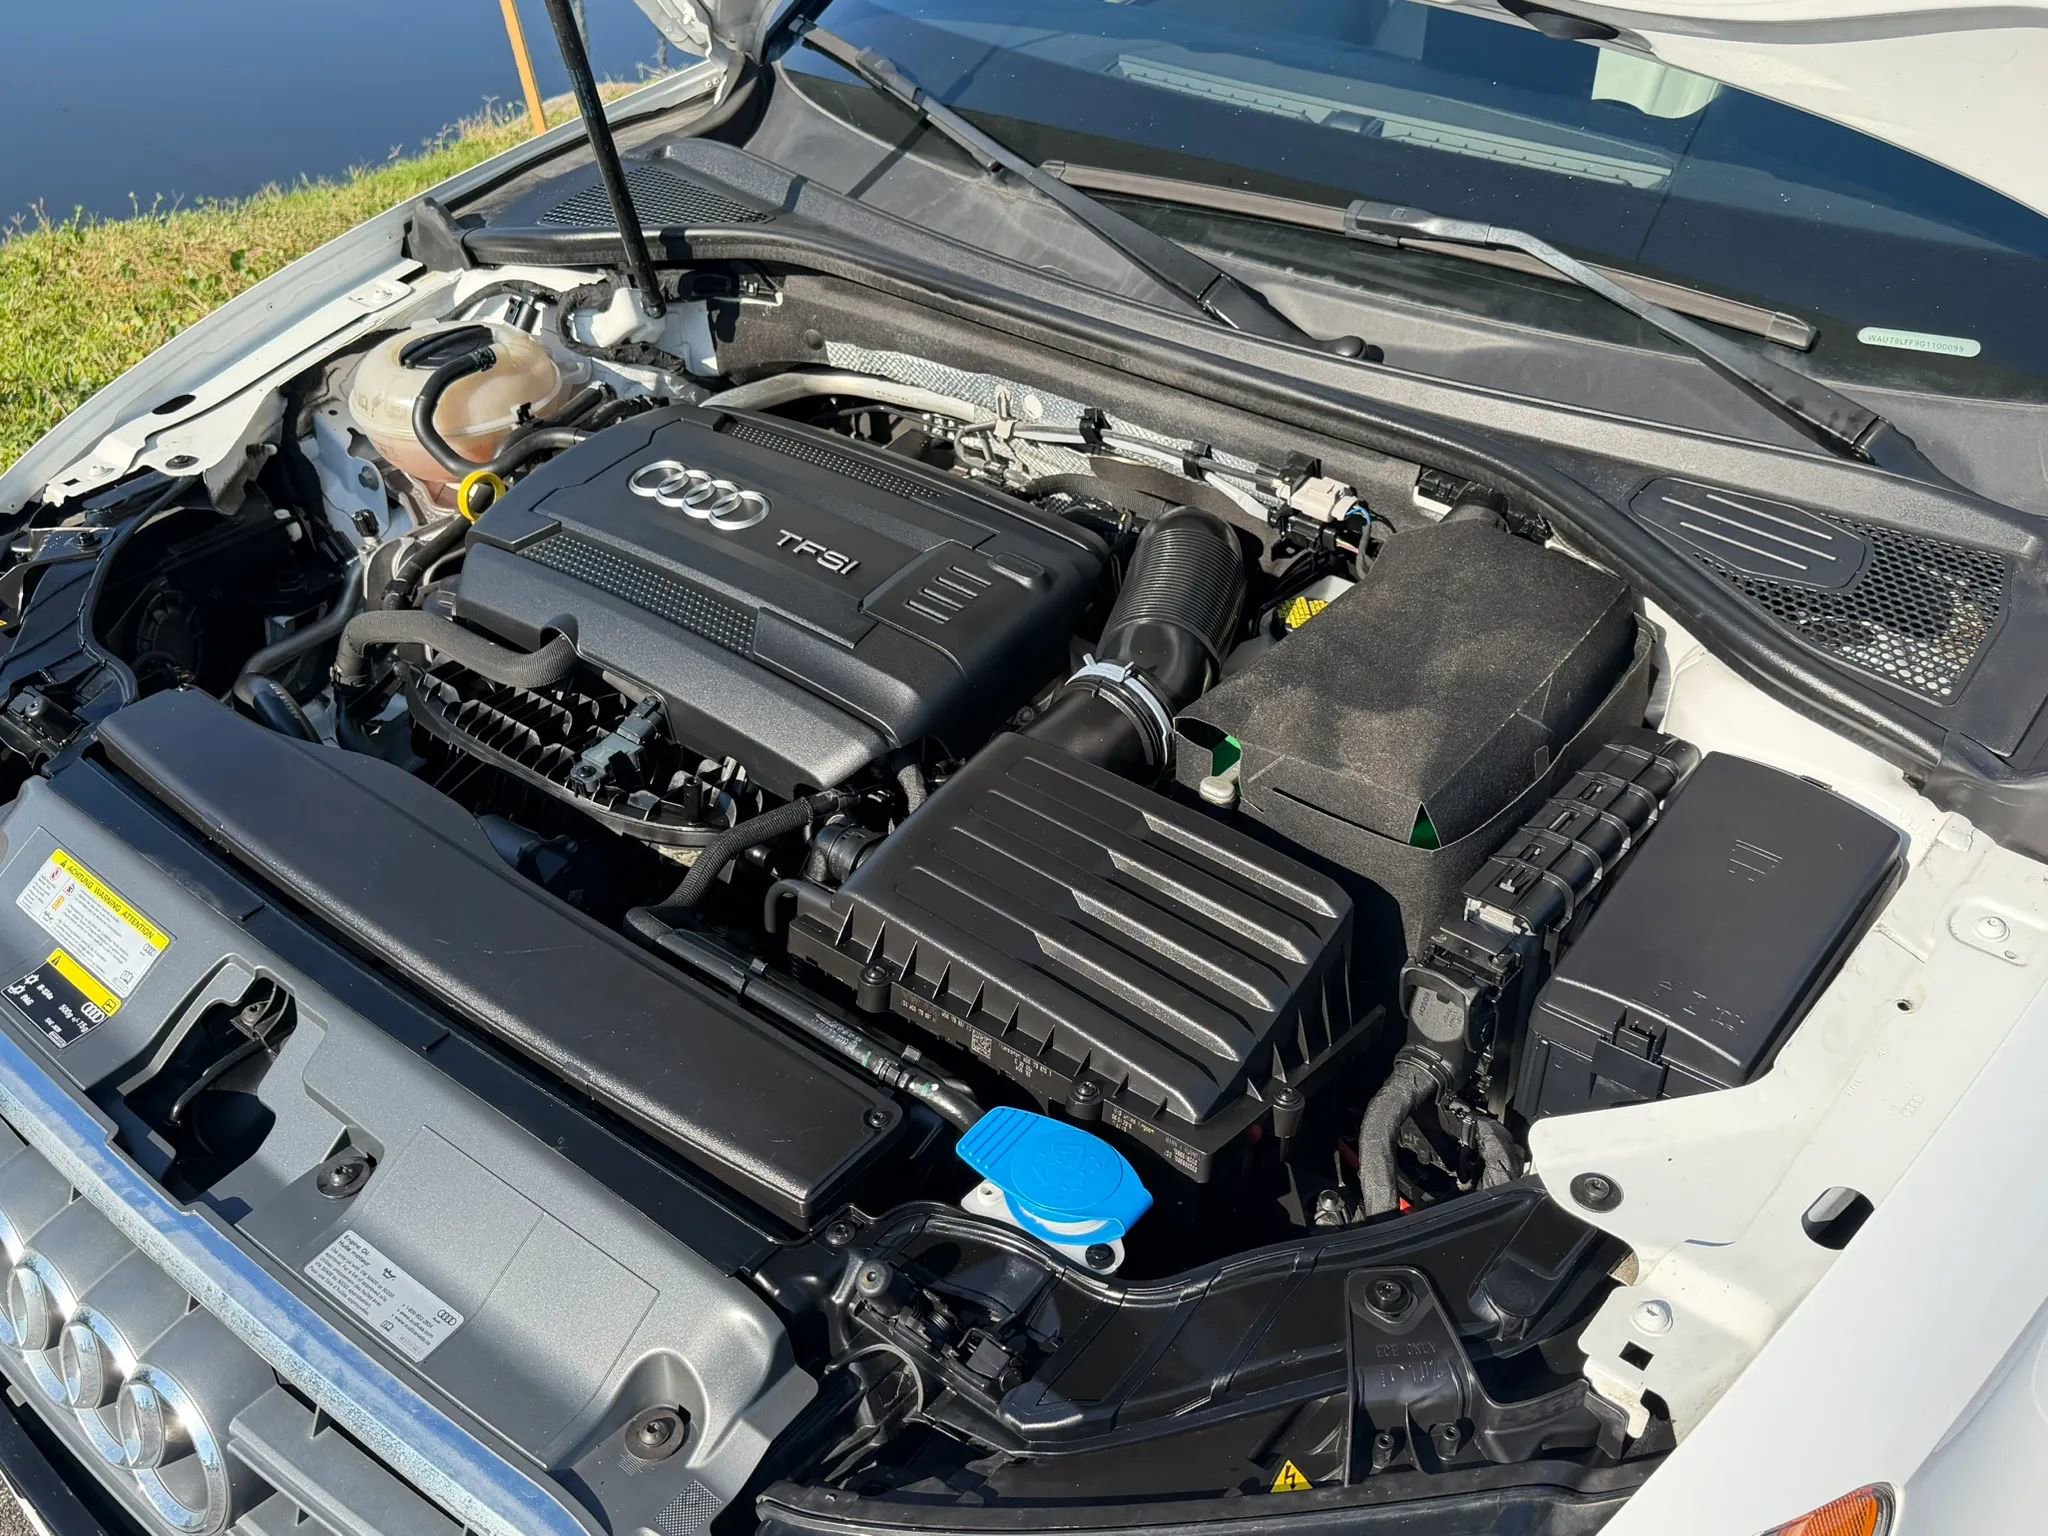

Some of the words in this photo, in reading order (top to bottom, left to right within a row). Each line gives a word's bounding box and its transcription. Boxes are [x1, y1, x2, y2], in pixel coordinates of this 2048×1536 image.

[776, 528, 861, 576] TFSI
[66, 864, 94, 889] ACHTUNG
[92, 886, 122, 912] WARNING
[121, 910, 154, 939] ATTENTION
[19, 993, 34, 1006] PAG
[58, 1004, 73, 1019] 500g
[76, 1020, 89, 1033] 15g
[337, 1239, 352, 1252] Huile
[350, 1250, 371, 1267] moteur
[342, 1234, 362, 1250] Engine
[359, 1247, 370, 1256] Oil
